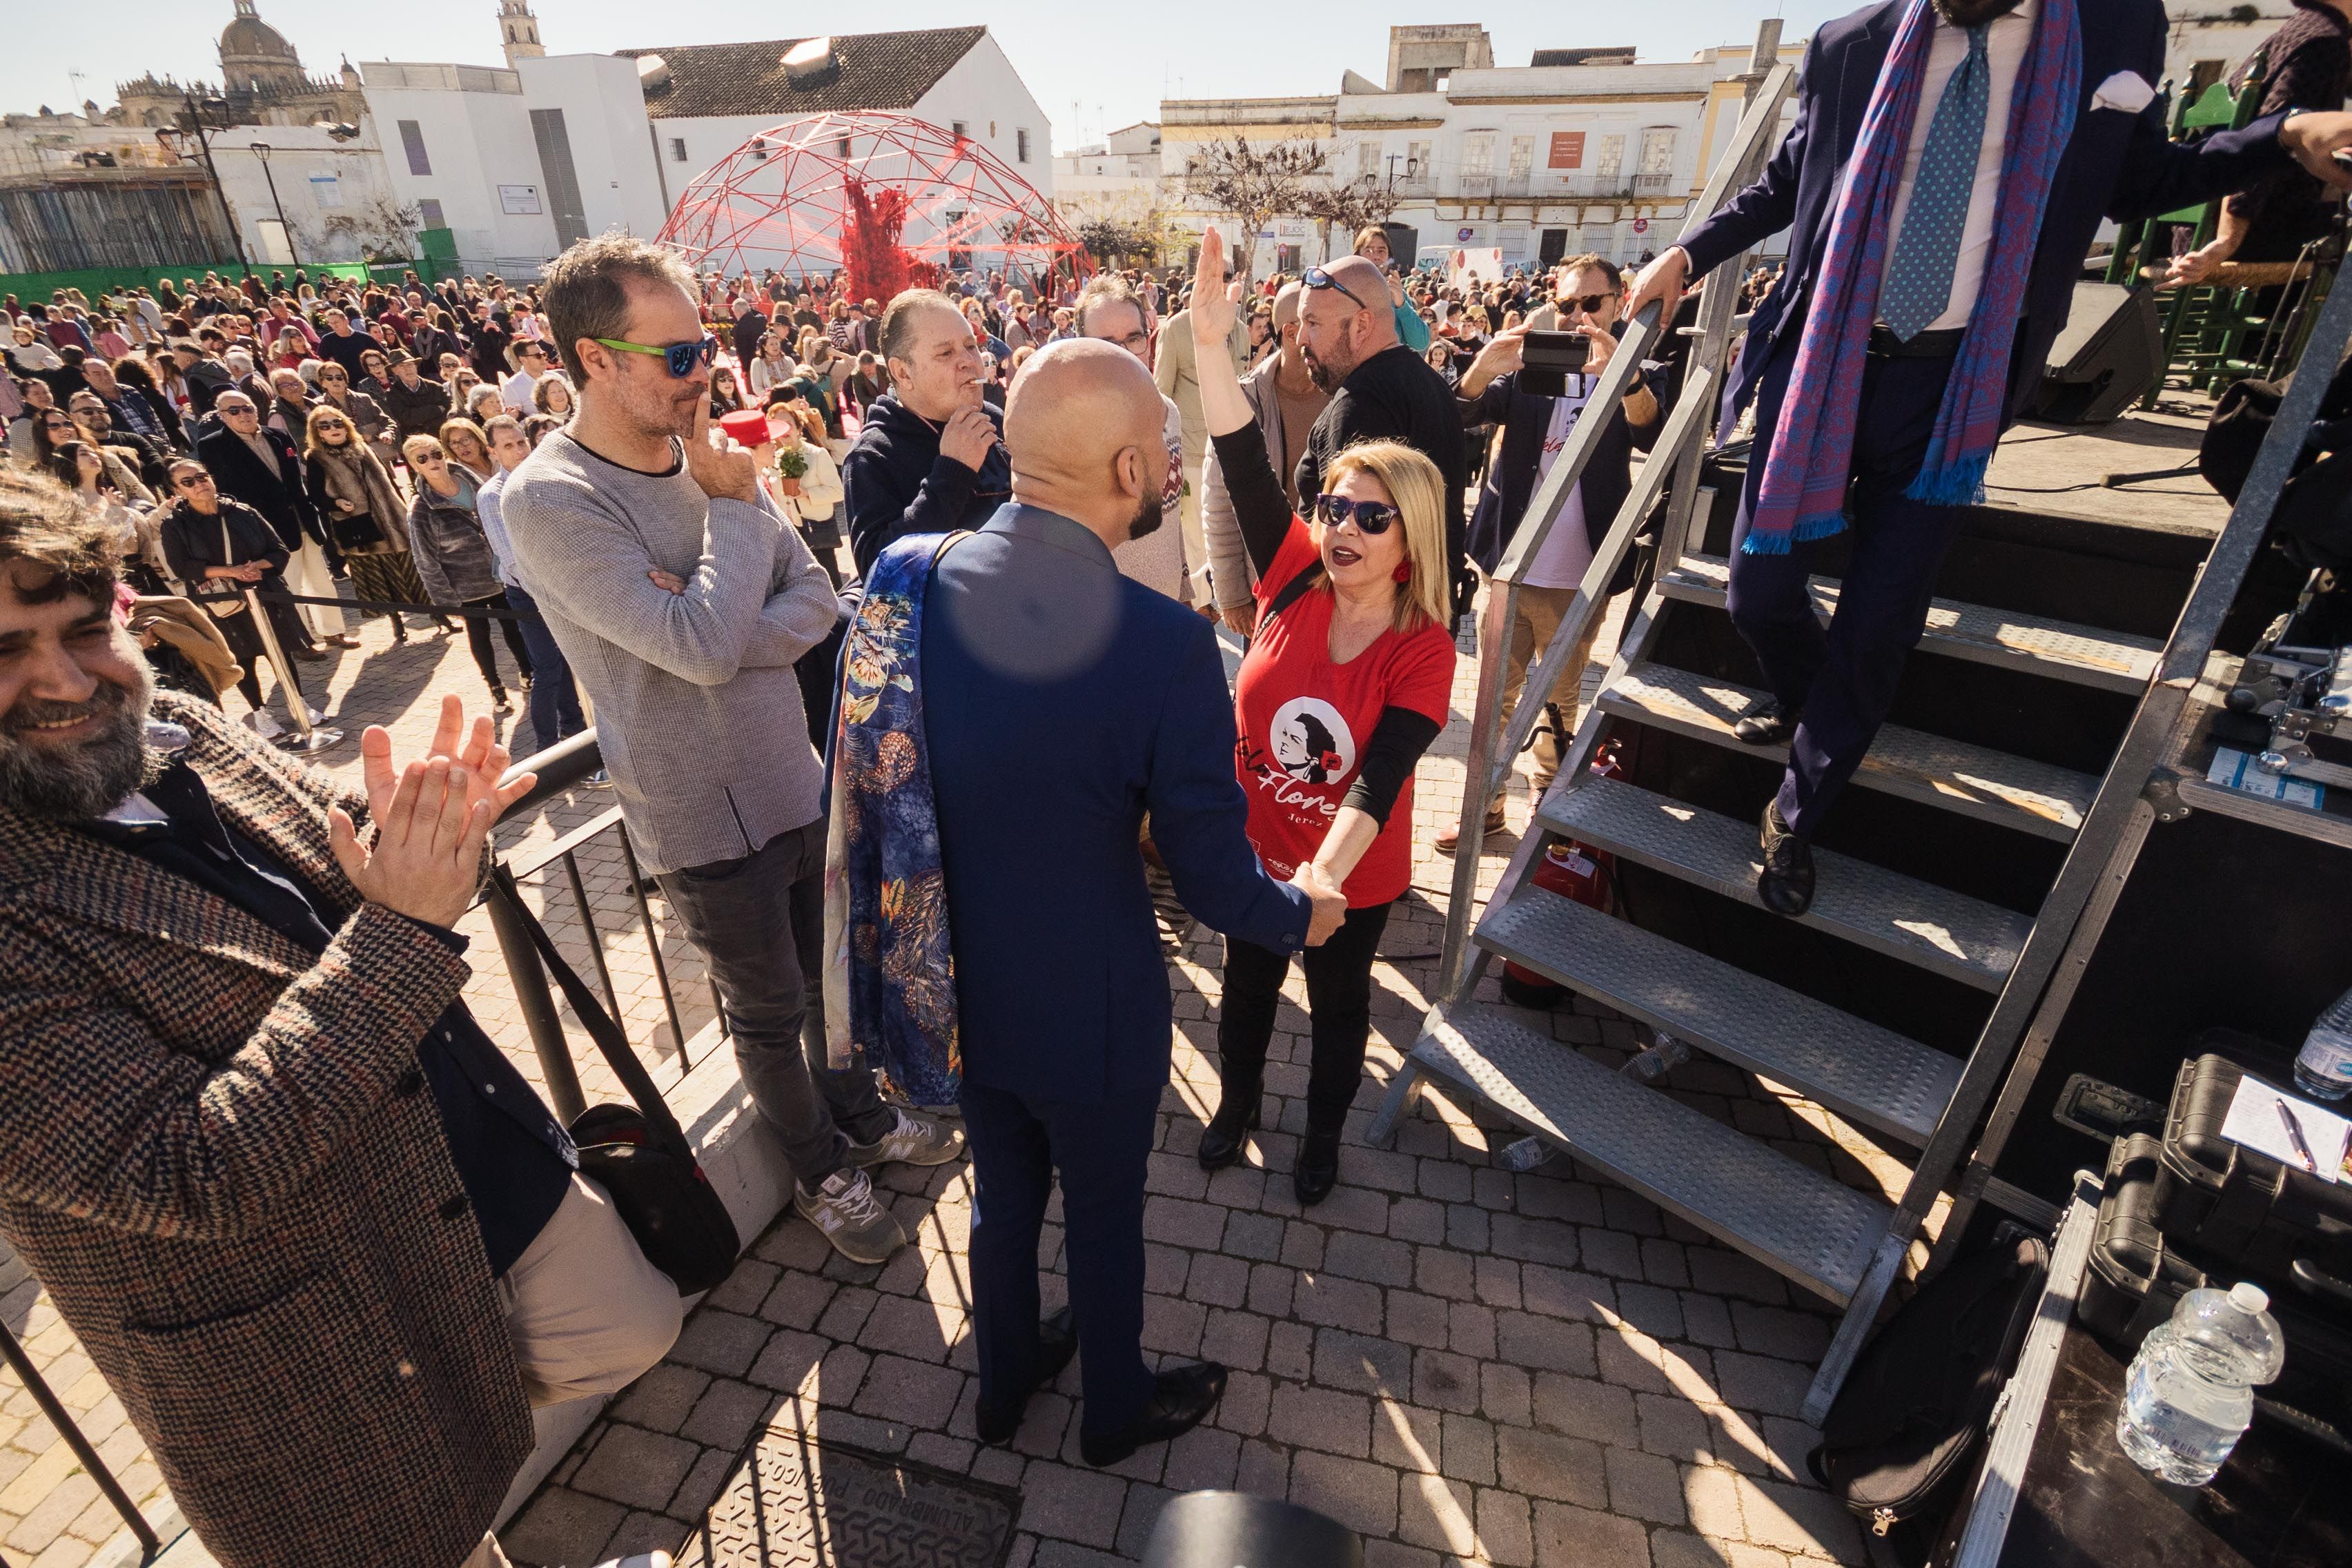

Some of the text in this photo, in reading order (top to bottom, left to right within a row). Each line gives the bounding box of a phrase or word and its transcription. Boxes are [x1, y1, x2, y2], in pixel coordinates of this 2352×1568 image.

[1257, 763, 1337, 821] Flore
[1287, 812, 1322, 827] Jerez
[814, 1206, 845, 1235] N
